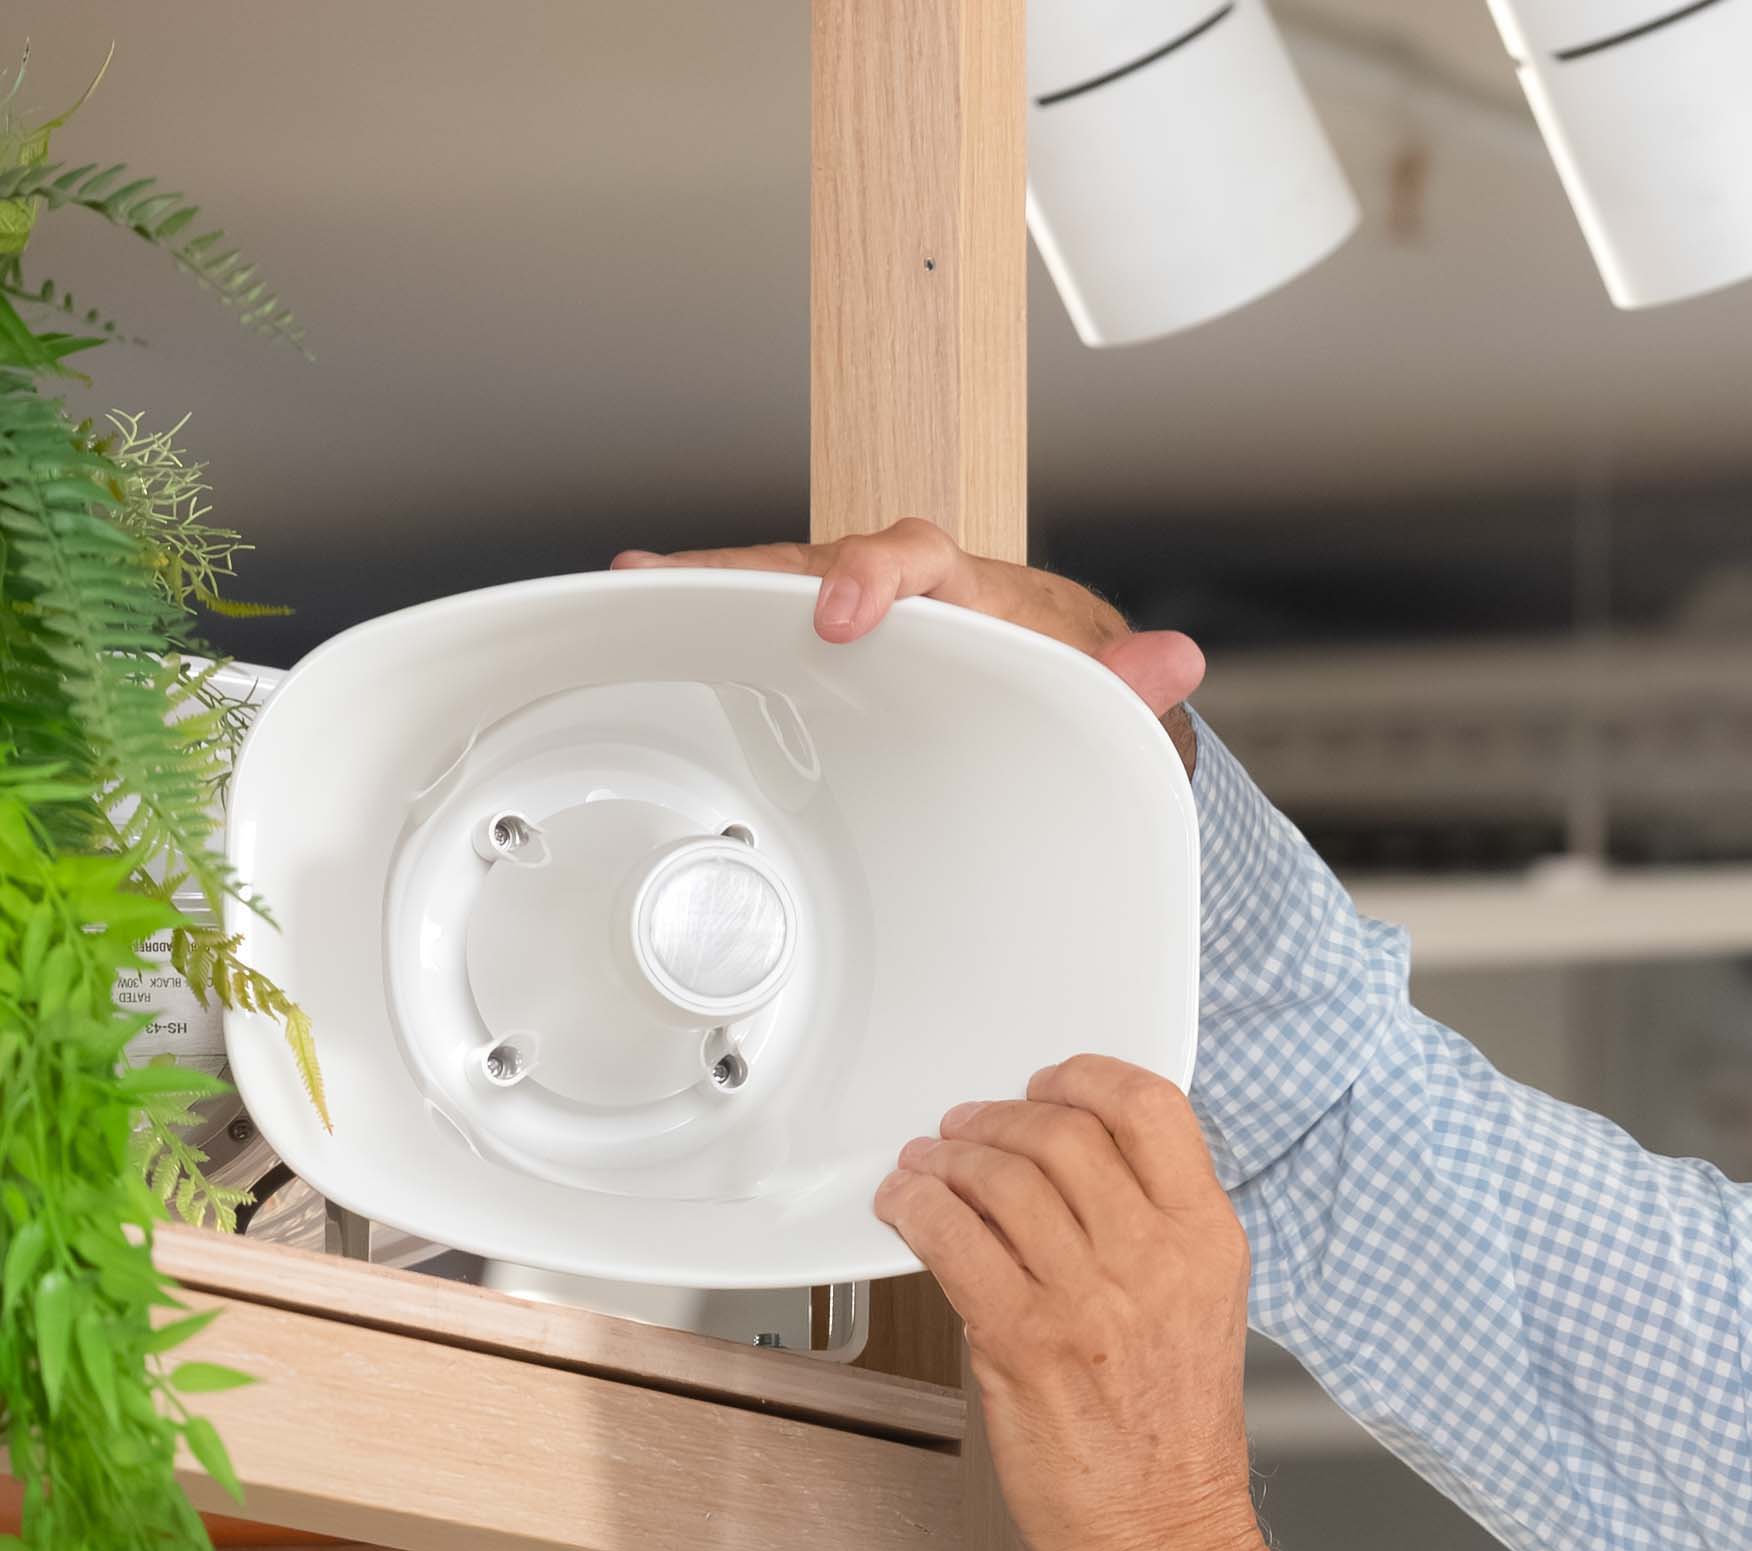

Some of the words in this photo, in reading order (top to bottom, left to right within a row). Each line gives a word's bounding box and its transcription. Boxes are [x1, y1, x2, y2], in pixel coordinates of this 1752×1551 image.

[117, 977, 139, 988] 30W
[151, 977, 182, 988] BLACK
[119, 992, 151, 1003] RATED
